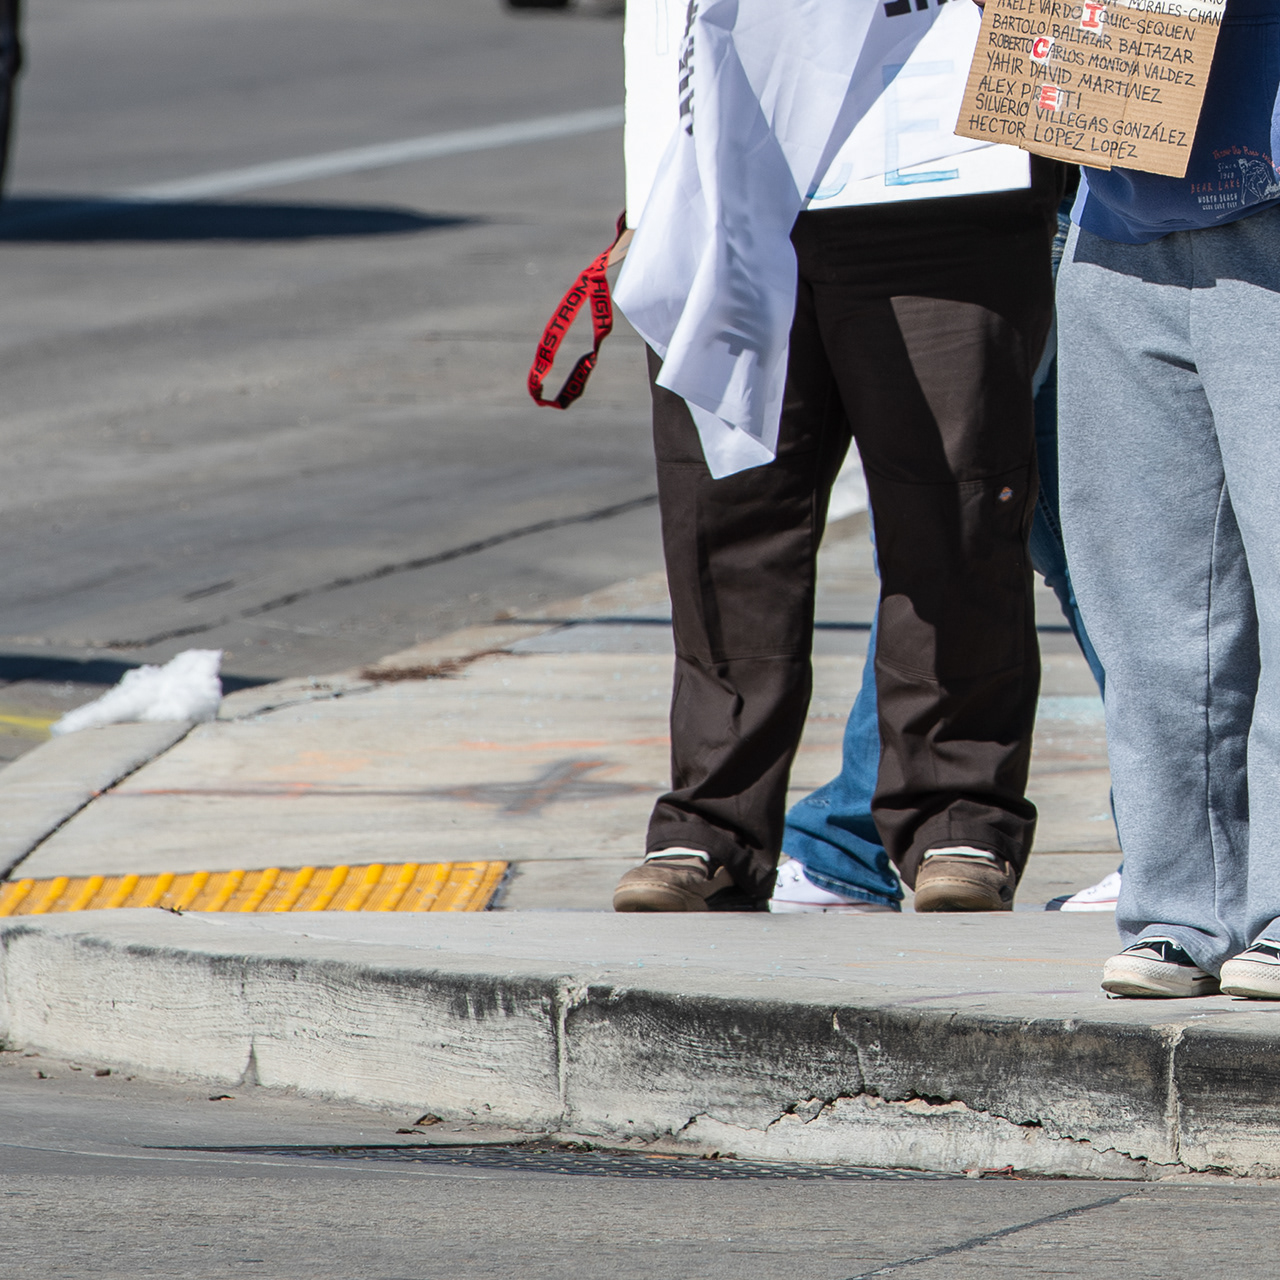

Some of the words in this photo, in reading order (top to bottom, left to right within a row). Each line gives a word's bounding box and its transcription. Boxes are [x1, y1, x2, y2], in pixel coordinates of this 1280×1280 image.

[992, 13, 1046, 35] BARTOLO
[1052, 24, 1112, 51] BALTAZAR
[1119, 38, 1194, 64] BALTAZAR
[1082, 2, 1196, 42] IQUIC-SEQUEN
[987, 51, 1024, 75] YAHIR
[1030, 62, 1073, 85] DAVID
[1078, 73, 1162, 104] MARTINEZ
[989, 32, 1033, 55] ROBERTO
[1033, 37, 1085, 66] CARLOS
[1088, 54, 1141, 78] MONTOYA
[1144, 64, 1196, 87] VALDEZ
[978, 75, 1015, 97] ALEX
[969, 114, 1026, 138] HECTOR
[1034, 126, 1085, 152] LOPEZ
[1091, 137, 1138, 159] LOPEZ
[975, 93, 1030, 117] SILVERIO
[1036, 106, 1108, 134] VILLEGAS
[1113, 120, 1188, 147] GONZÁLEZ
[592, 278, 610, 331] HIGH
